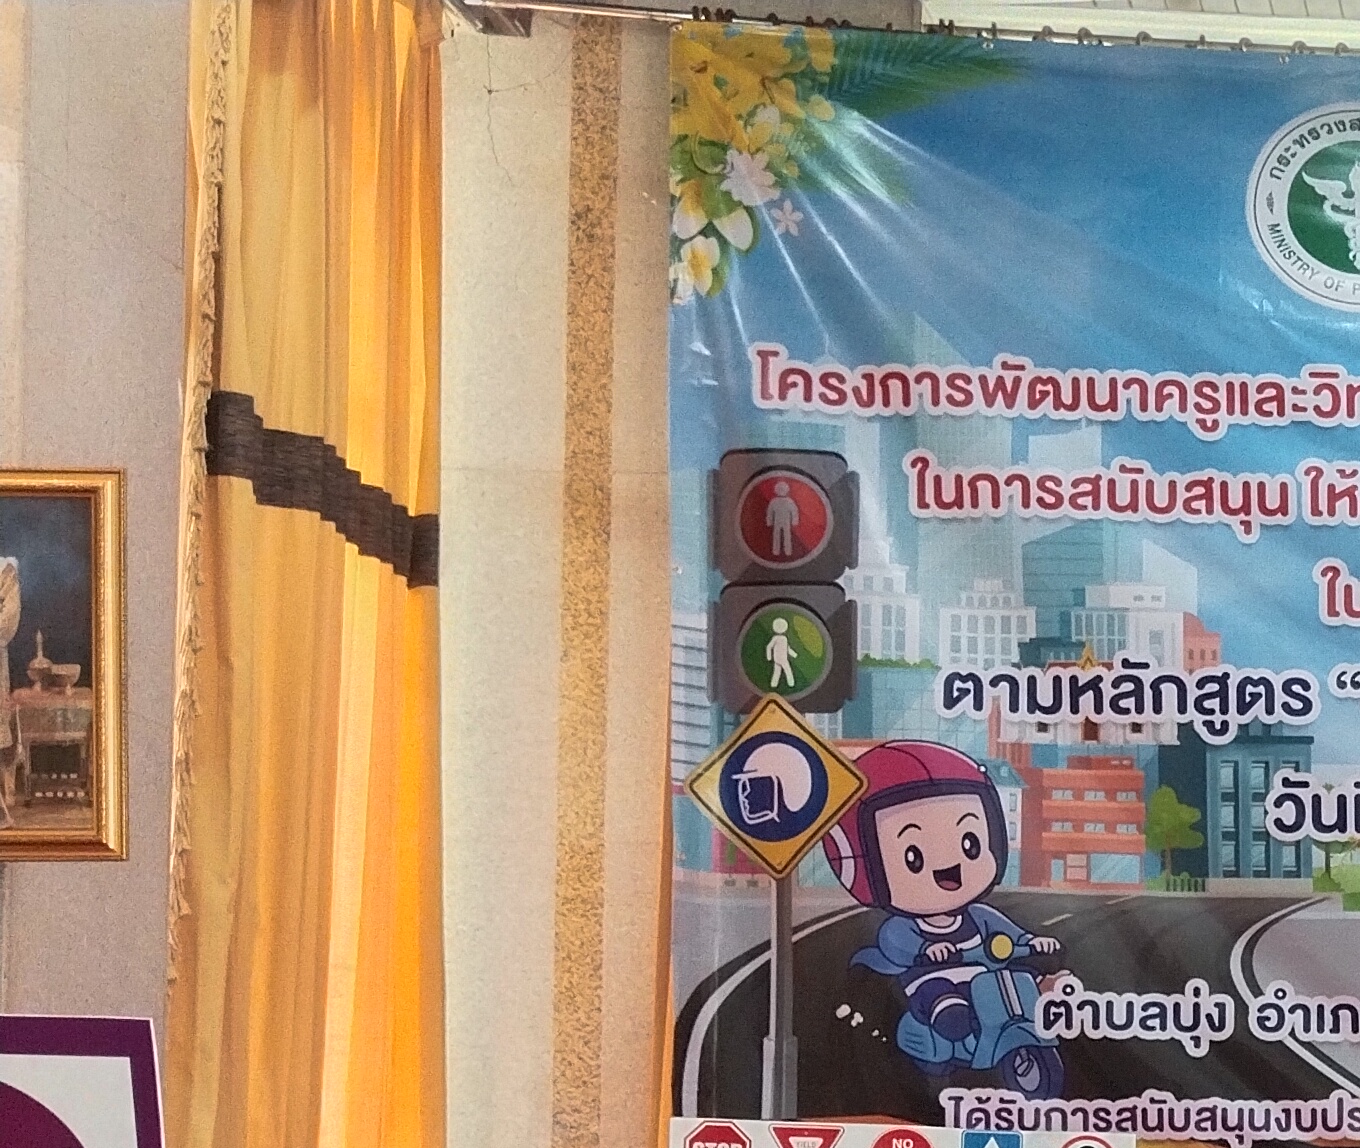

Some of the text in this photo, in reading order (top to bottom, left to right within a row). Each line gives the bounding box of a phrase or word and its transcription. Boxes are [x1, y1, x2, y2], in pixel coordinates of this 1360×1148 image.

[1267, 222, 1320, 281] MINISTRY
[1323, 276, 1346, 292] OF
[910, 458, 1291, 536] ในการสนับสนุน
[942, 657, 1314, 732] ตามหลักสูตร
[1042, 984, 1228, 1042] ตำบลบุ่ง
